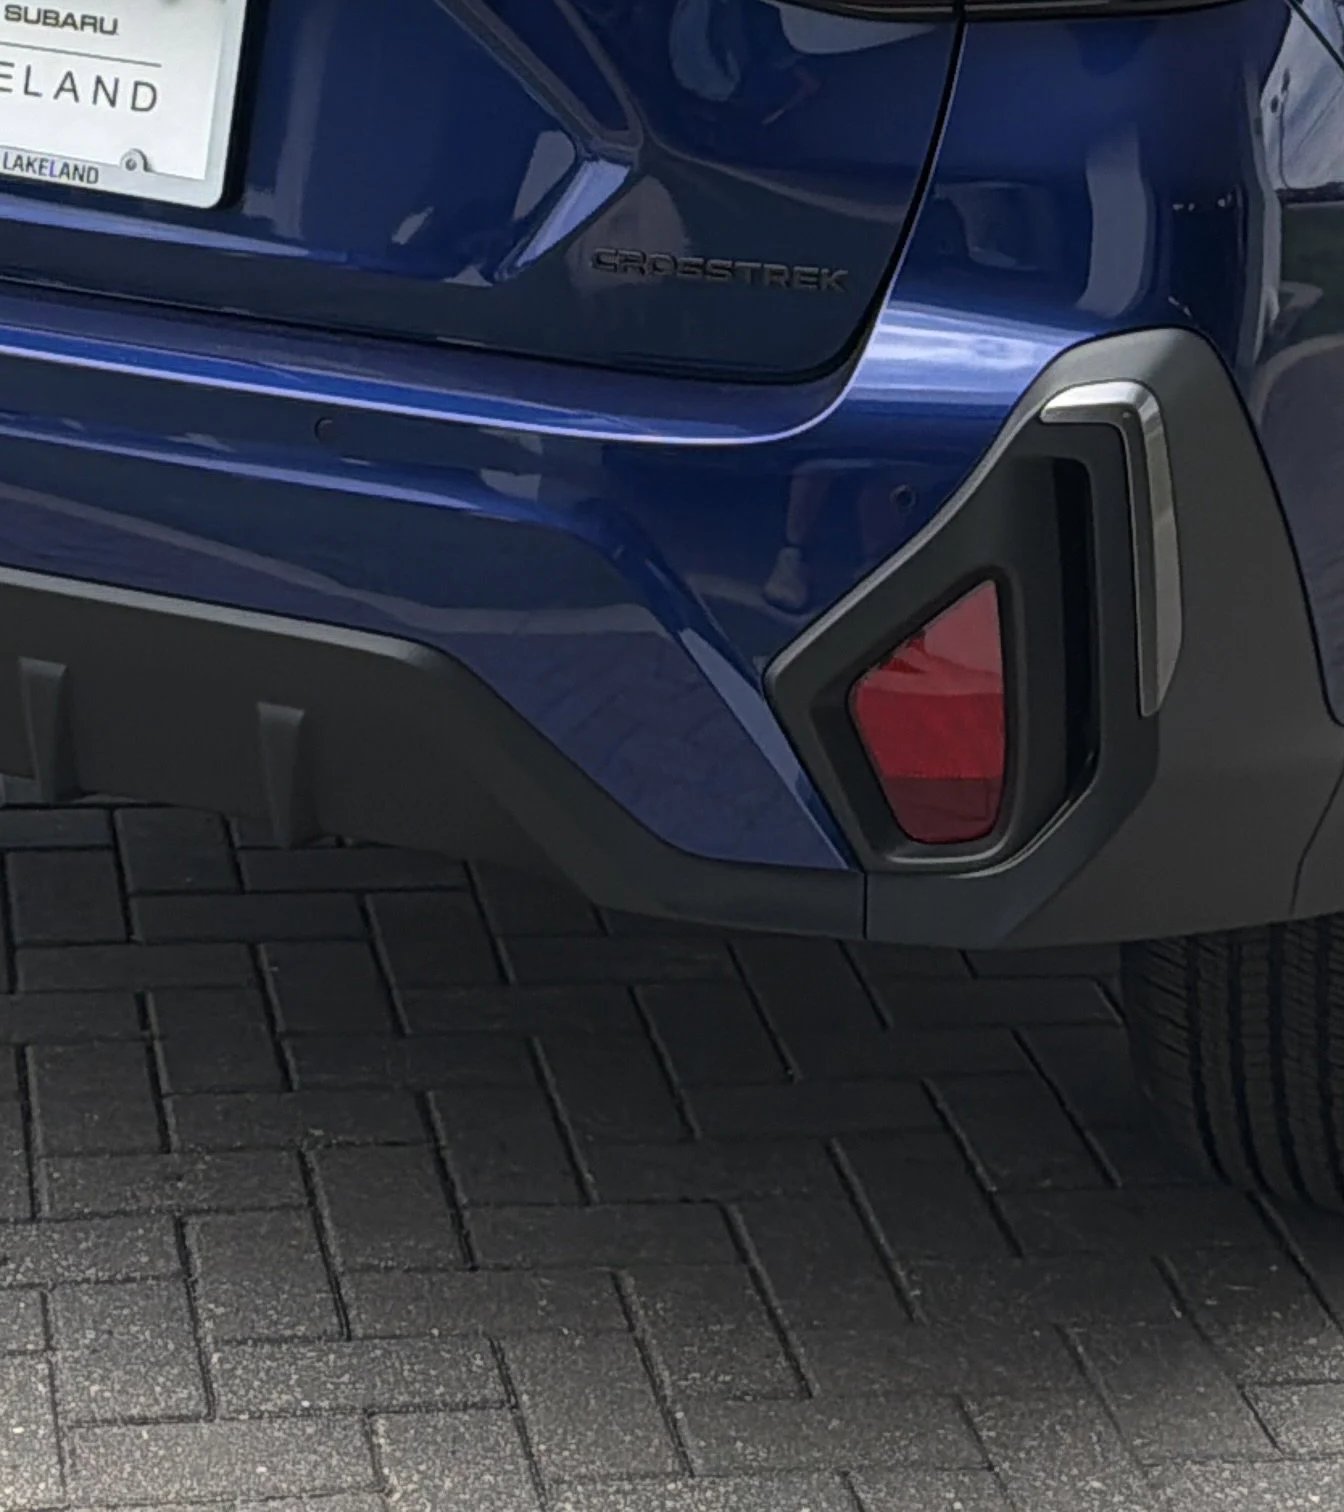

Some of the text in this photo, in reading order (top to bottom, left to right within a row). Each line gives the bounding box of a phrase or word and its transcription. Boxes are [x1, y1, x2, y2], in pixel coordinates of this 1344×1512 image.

[3, 4, 119, 36] SUBARU
[3, 151, 100, 185] LAKELAND
[591, 247, 849, 291] CROSSTREK
